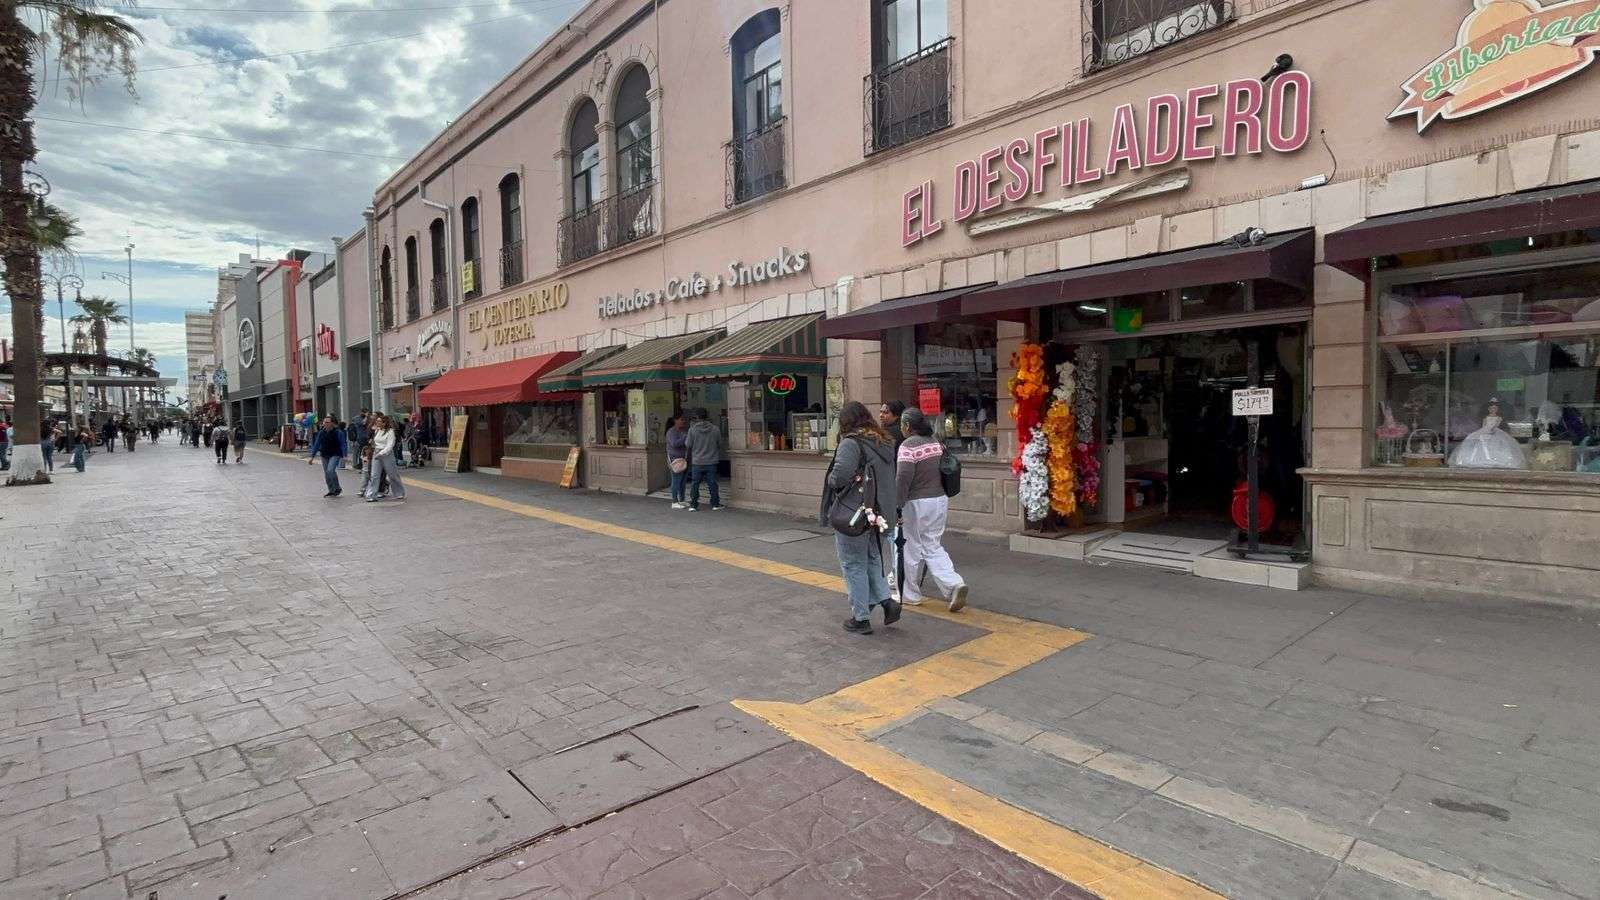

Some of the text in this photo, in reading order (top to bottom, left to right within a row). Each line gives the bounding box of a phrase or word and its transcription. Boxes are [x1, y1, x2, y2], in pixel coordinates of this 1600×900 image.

[902, 69, 1312, 248] EL DESFILADERO
[468, 281, 570, 332] EL CENTENARIO
[598, 288, 653, 318] Helados
[727, 246, 810, 288] Snacks
[770, 376, 794, 391] OEN
